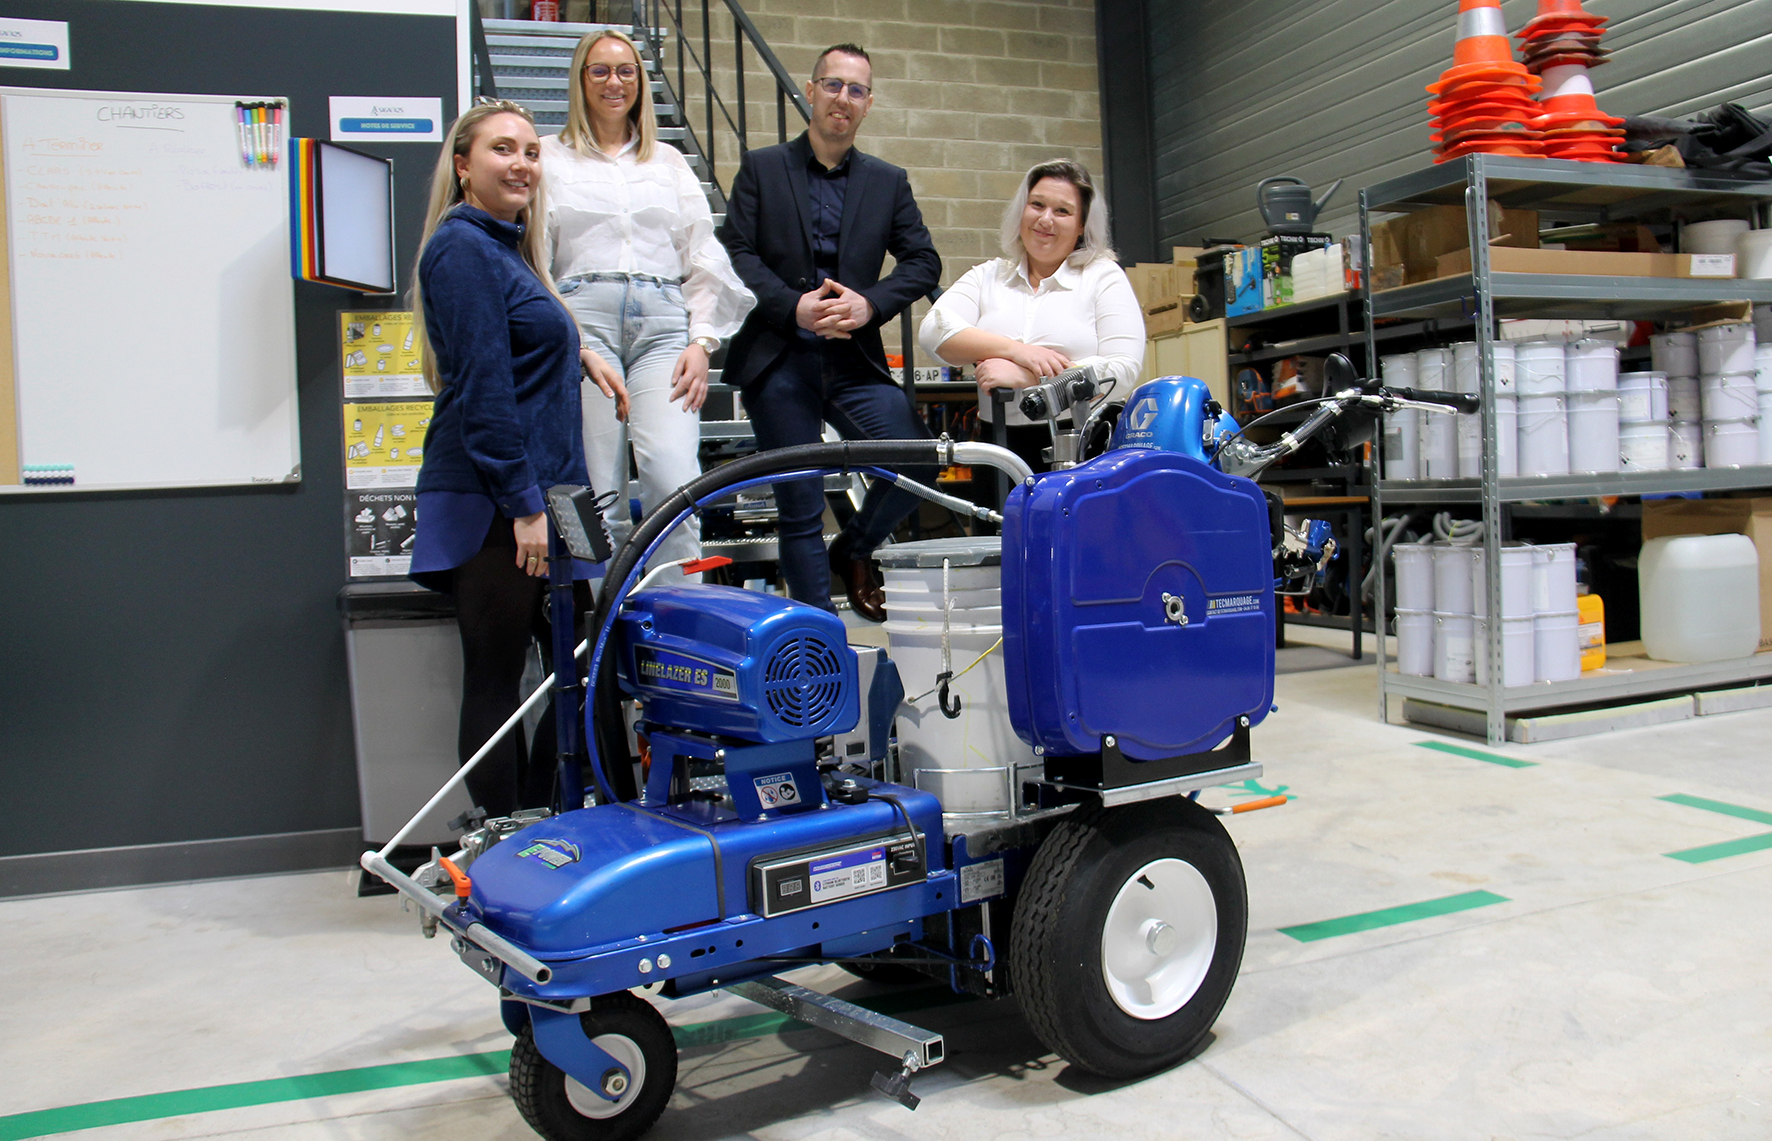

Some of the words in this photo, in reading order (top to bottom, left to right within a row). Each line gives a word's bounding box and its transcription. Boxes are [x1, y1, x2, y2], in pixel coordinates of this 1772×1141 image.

[1125, 431, 1154, 439] GRACO
[640, 660, 692, 683] LINELAZER
[694, 668, 709, 686] ES
[715, 677, 731, 690] 2000
[760, 775, 786, 785] NOTICE
